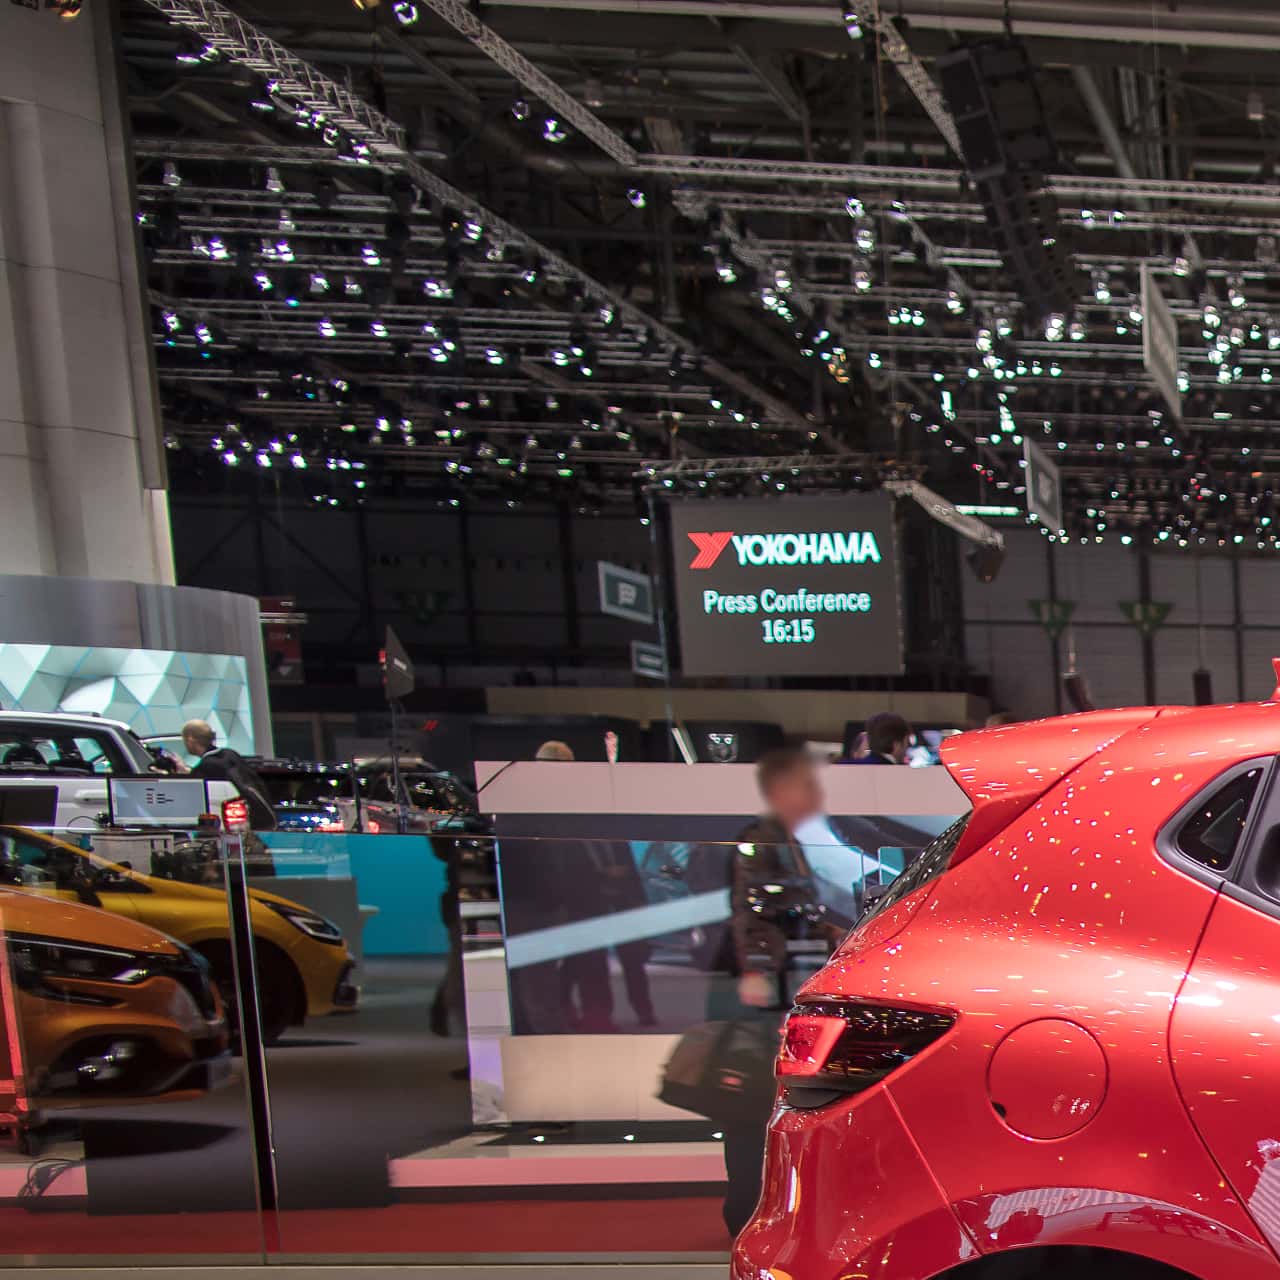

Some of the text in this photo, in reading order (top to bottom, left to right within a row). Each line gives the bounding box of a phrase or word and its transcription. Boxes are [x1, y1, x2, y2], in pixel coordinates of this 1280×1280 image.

[731, 532, 882, 566] YOKOHAMA
[703, 588, 872, 614] Press Conference
[761, 618, 816, 643] 16:15
